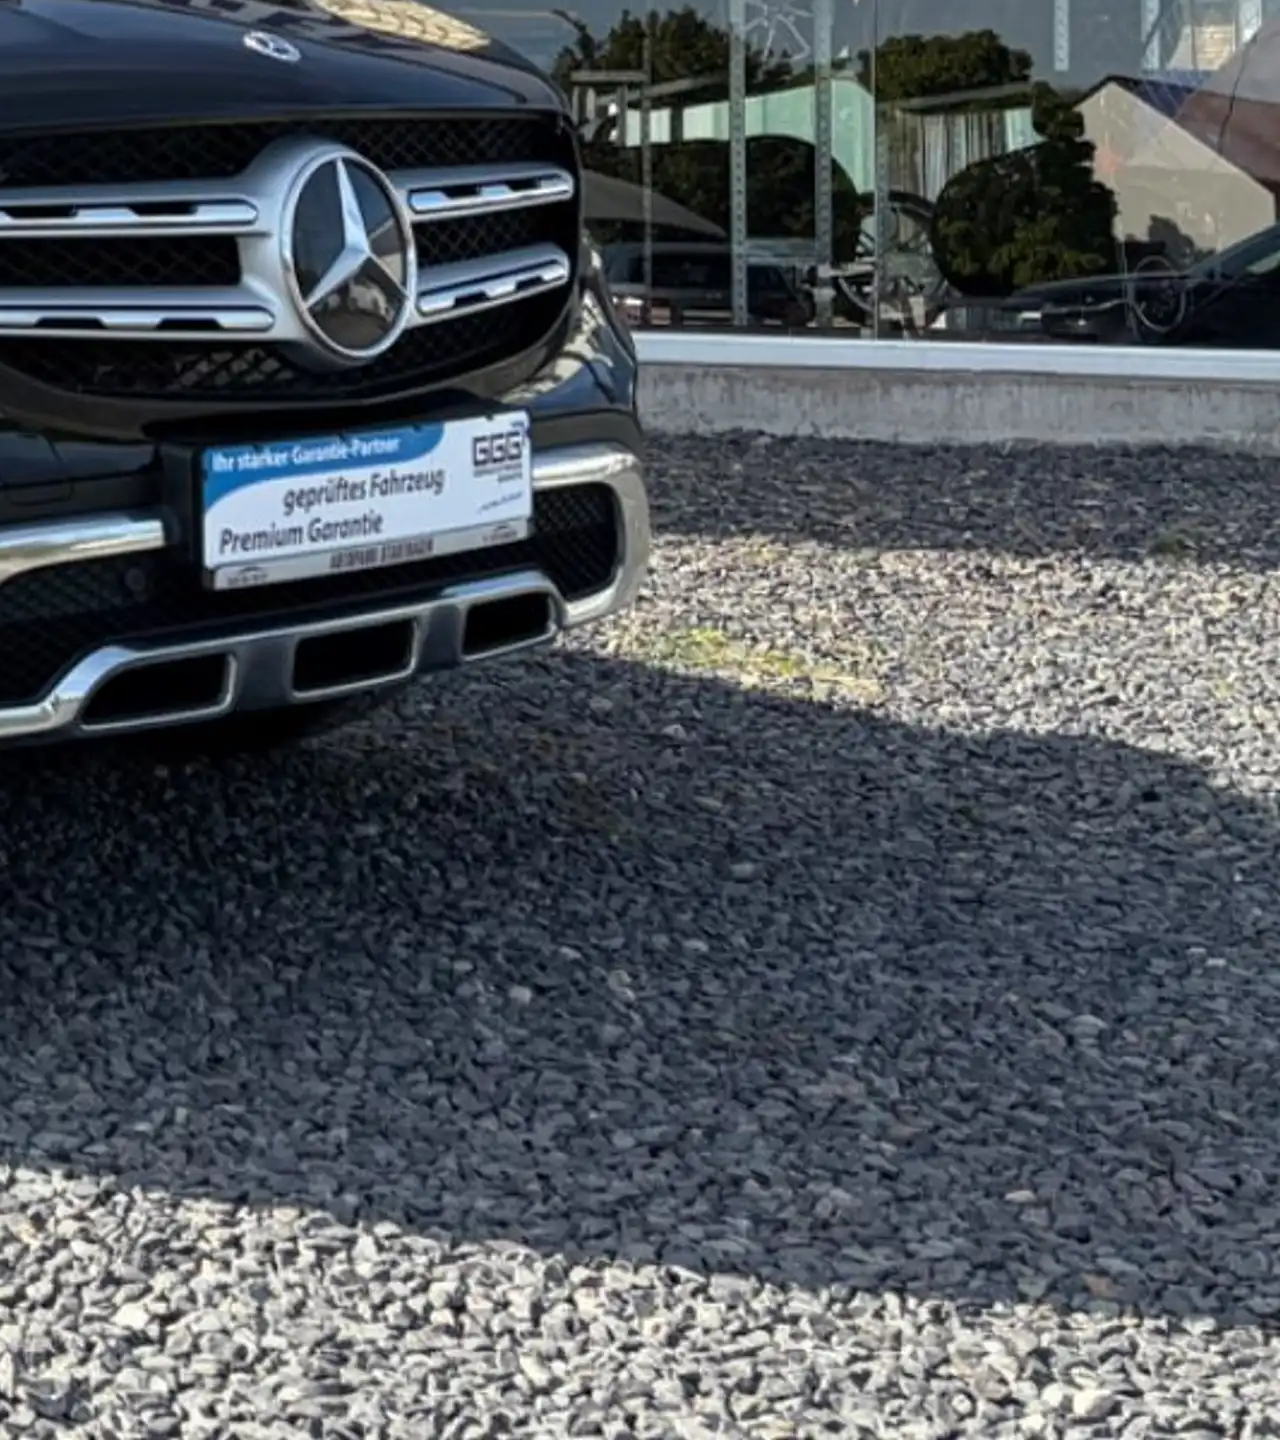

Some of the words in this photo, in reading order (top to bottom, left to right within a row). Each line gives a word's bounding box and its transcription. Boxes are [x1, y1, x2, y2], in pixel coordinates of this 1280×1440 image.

[211, 451, 234, 473] Ihr
[291, 435, 402, 464] Garantie-Partner
[282, 476, 367, 516] geprüftes
[369, 467, 445, 499] Fahrzeug
[219, 522, 304, 555] Premium
[307, 509, 384, 543] Garantie
